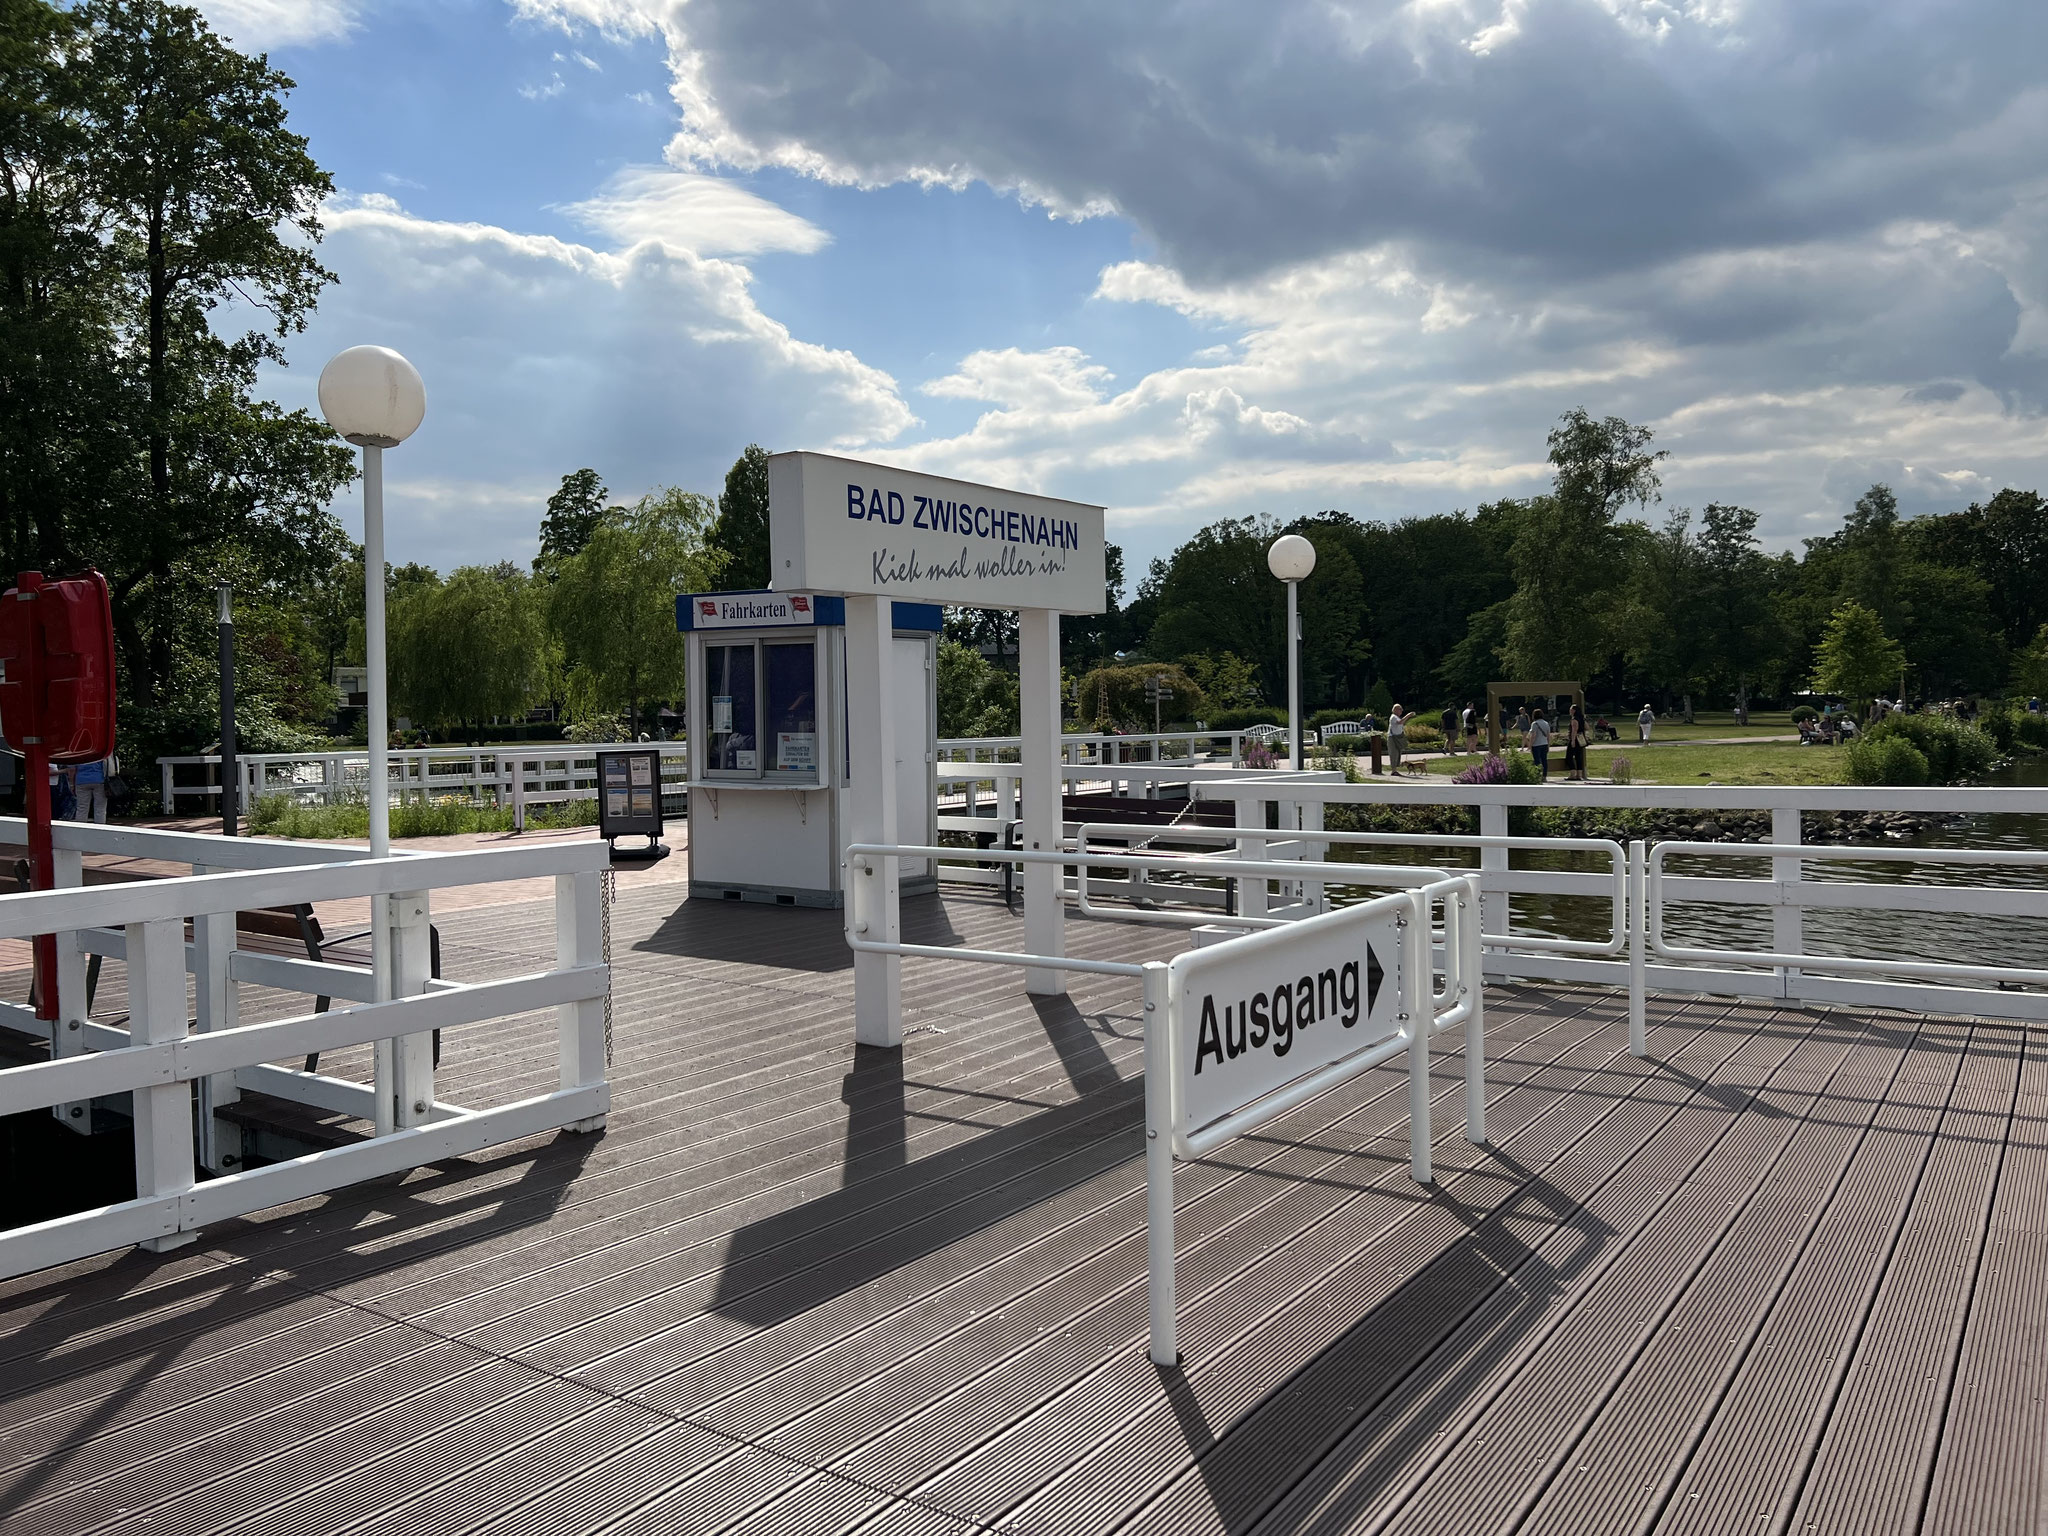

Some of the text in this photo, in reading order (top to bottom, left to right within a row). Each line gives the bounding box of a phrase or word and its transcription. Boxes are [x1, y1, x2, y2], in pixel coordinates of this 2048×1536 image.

[847, 484, 1078, 551] BAD ZWISCHENAHN
[872, 541, 1066, 584] Kiek mal woller in!
[721, 601, 787, 620] Fahrkarten
[1194, 960, 1360, 1076] Ausgang
